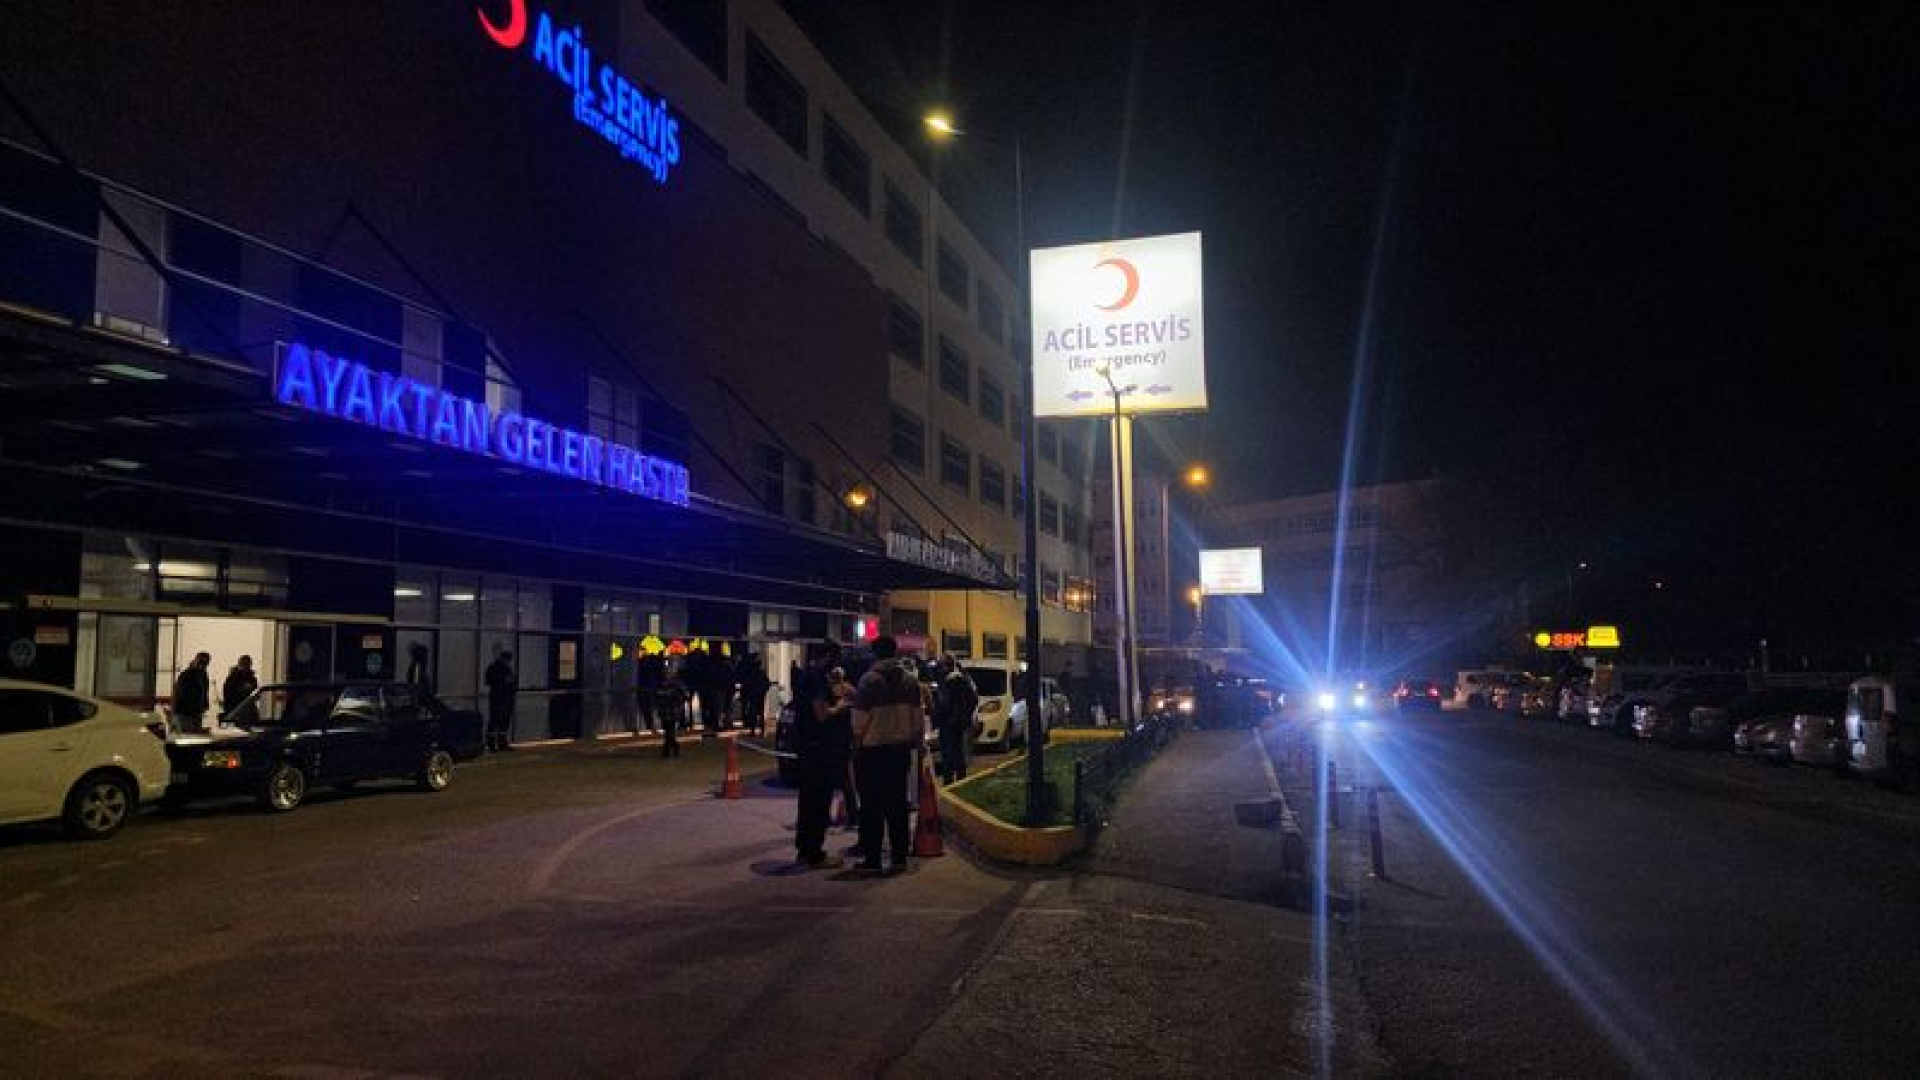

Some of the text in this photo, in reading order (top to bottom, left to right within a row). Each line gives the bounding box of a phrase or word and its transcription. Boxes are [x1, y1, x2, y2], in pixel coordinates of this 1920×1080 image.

[534, 12, 681, 165] ACİL SERVİS
[1043, 314, 1191, 351] ACİL SERVİS
[278, 342, 491, 454] AYAKTAN
[498, 413, 604, 484] GELEN
